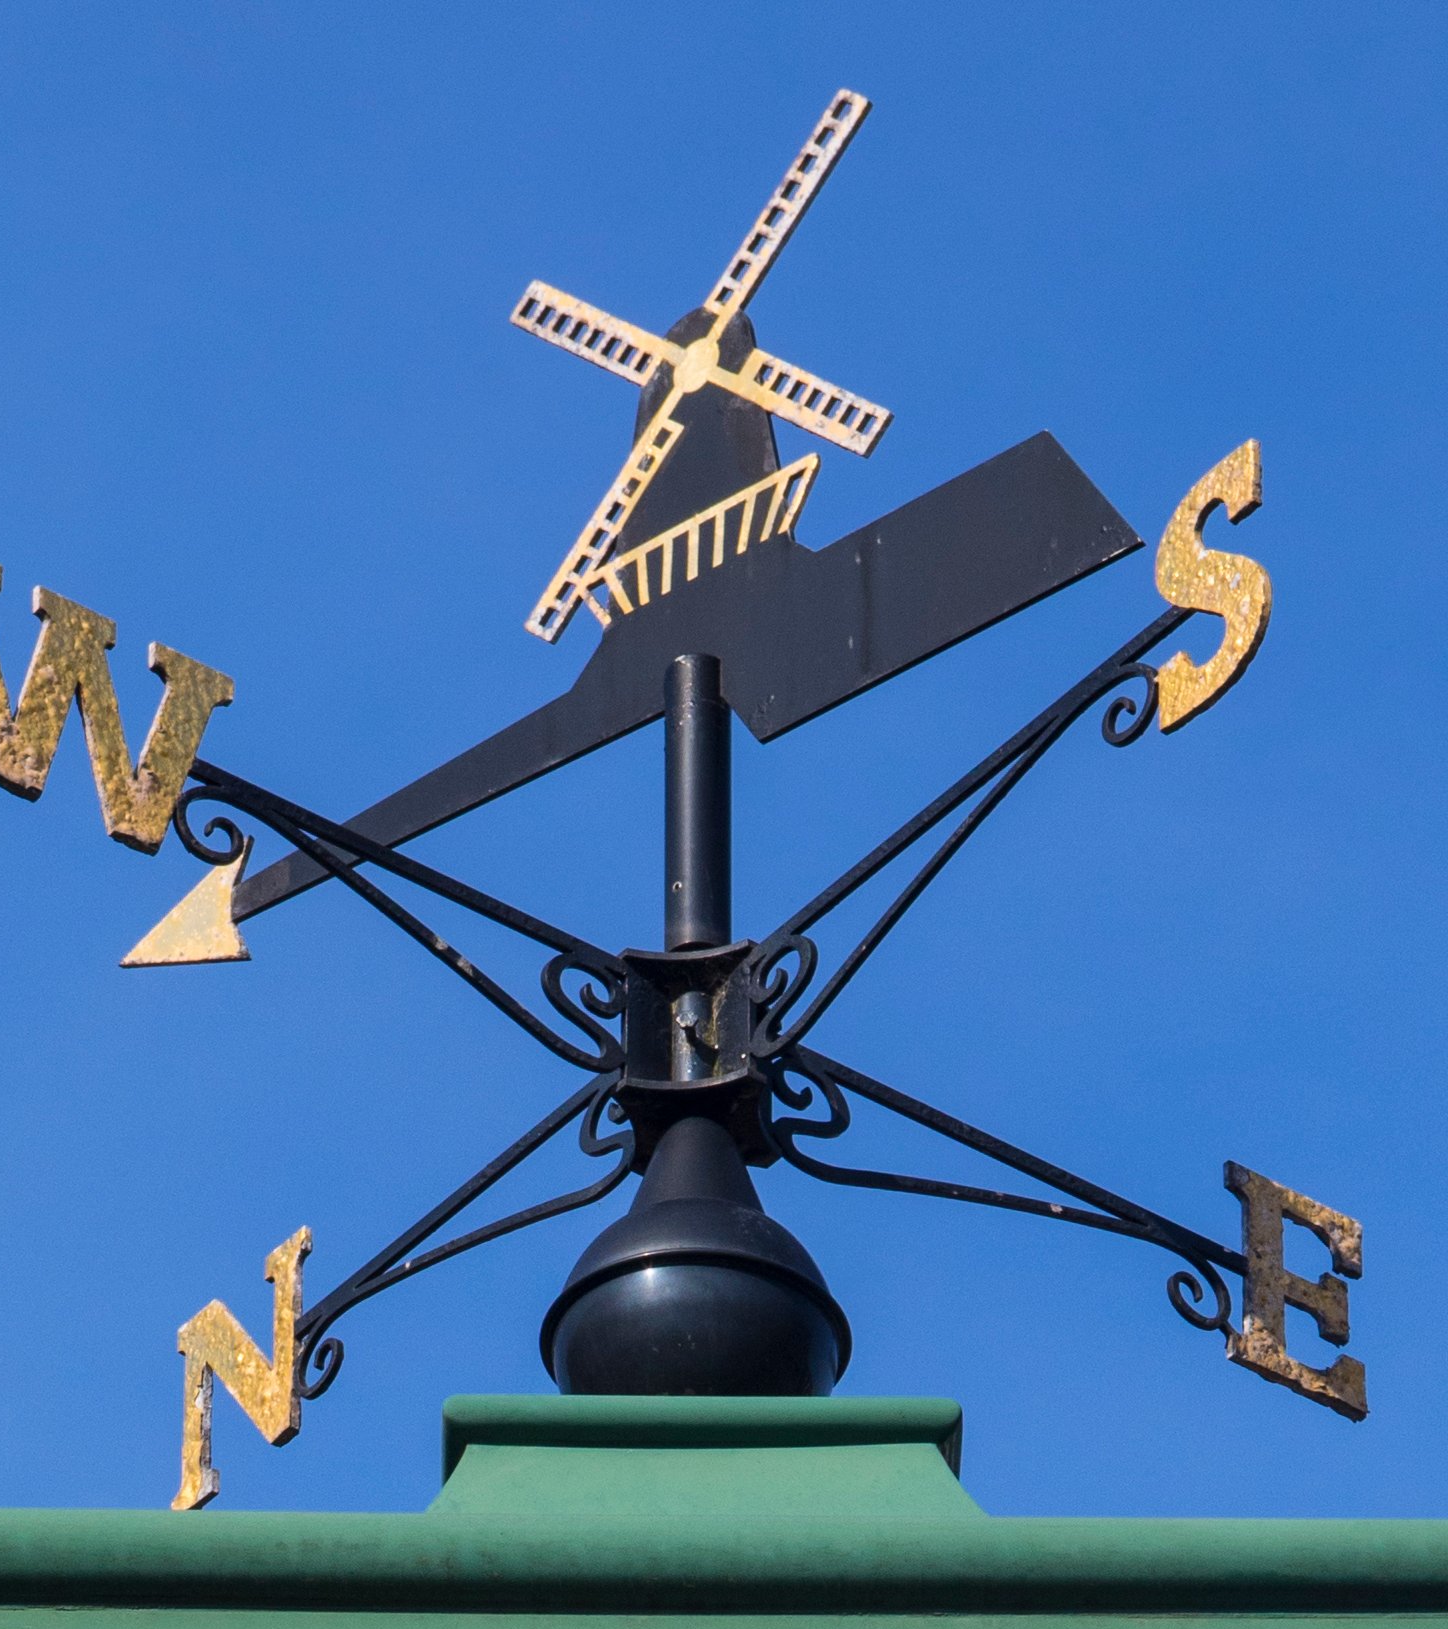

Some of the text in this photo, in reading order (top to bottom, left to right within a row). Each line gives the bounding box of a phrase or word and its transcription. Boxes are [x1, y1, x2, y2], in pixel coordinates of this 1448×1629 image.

[1155, 438, 1273, 735] S
[172, 1226, 312, 1513] N
[1223, 1160, 1368, 1422] E
